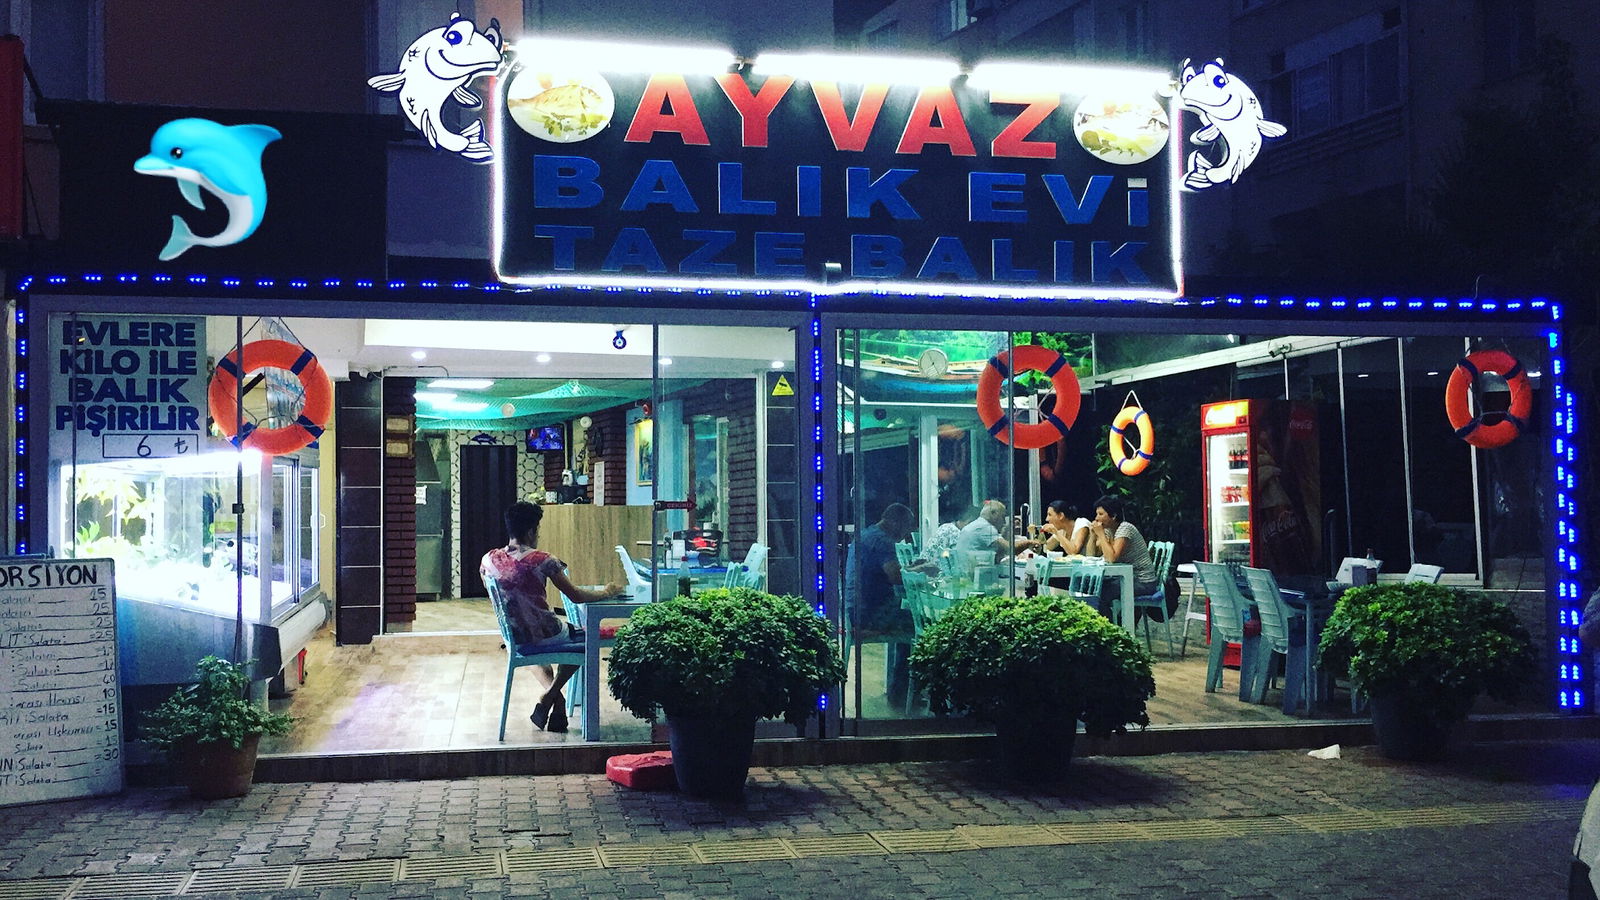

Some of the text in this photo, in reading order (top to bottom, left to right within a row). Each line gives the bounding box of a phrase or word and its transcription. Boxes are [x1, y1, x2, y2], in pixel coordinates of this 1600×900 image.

[623, 72, 1060, 160] AYVAZ
[533, 154, 921, 220] BALIK
[534, 224, 1152, 285] TAZE BALIK
[63, 320, 196, 347] EVLERE
[68, 377, 190, 403] BALIK
[136, 435, 152, 458] 6
[103, 687, 116, 699] 10
